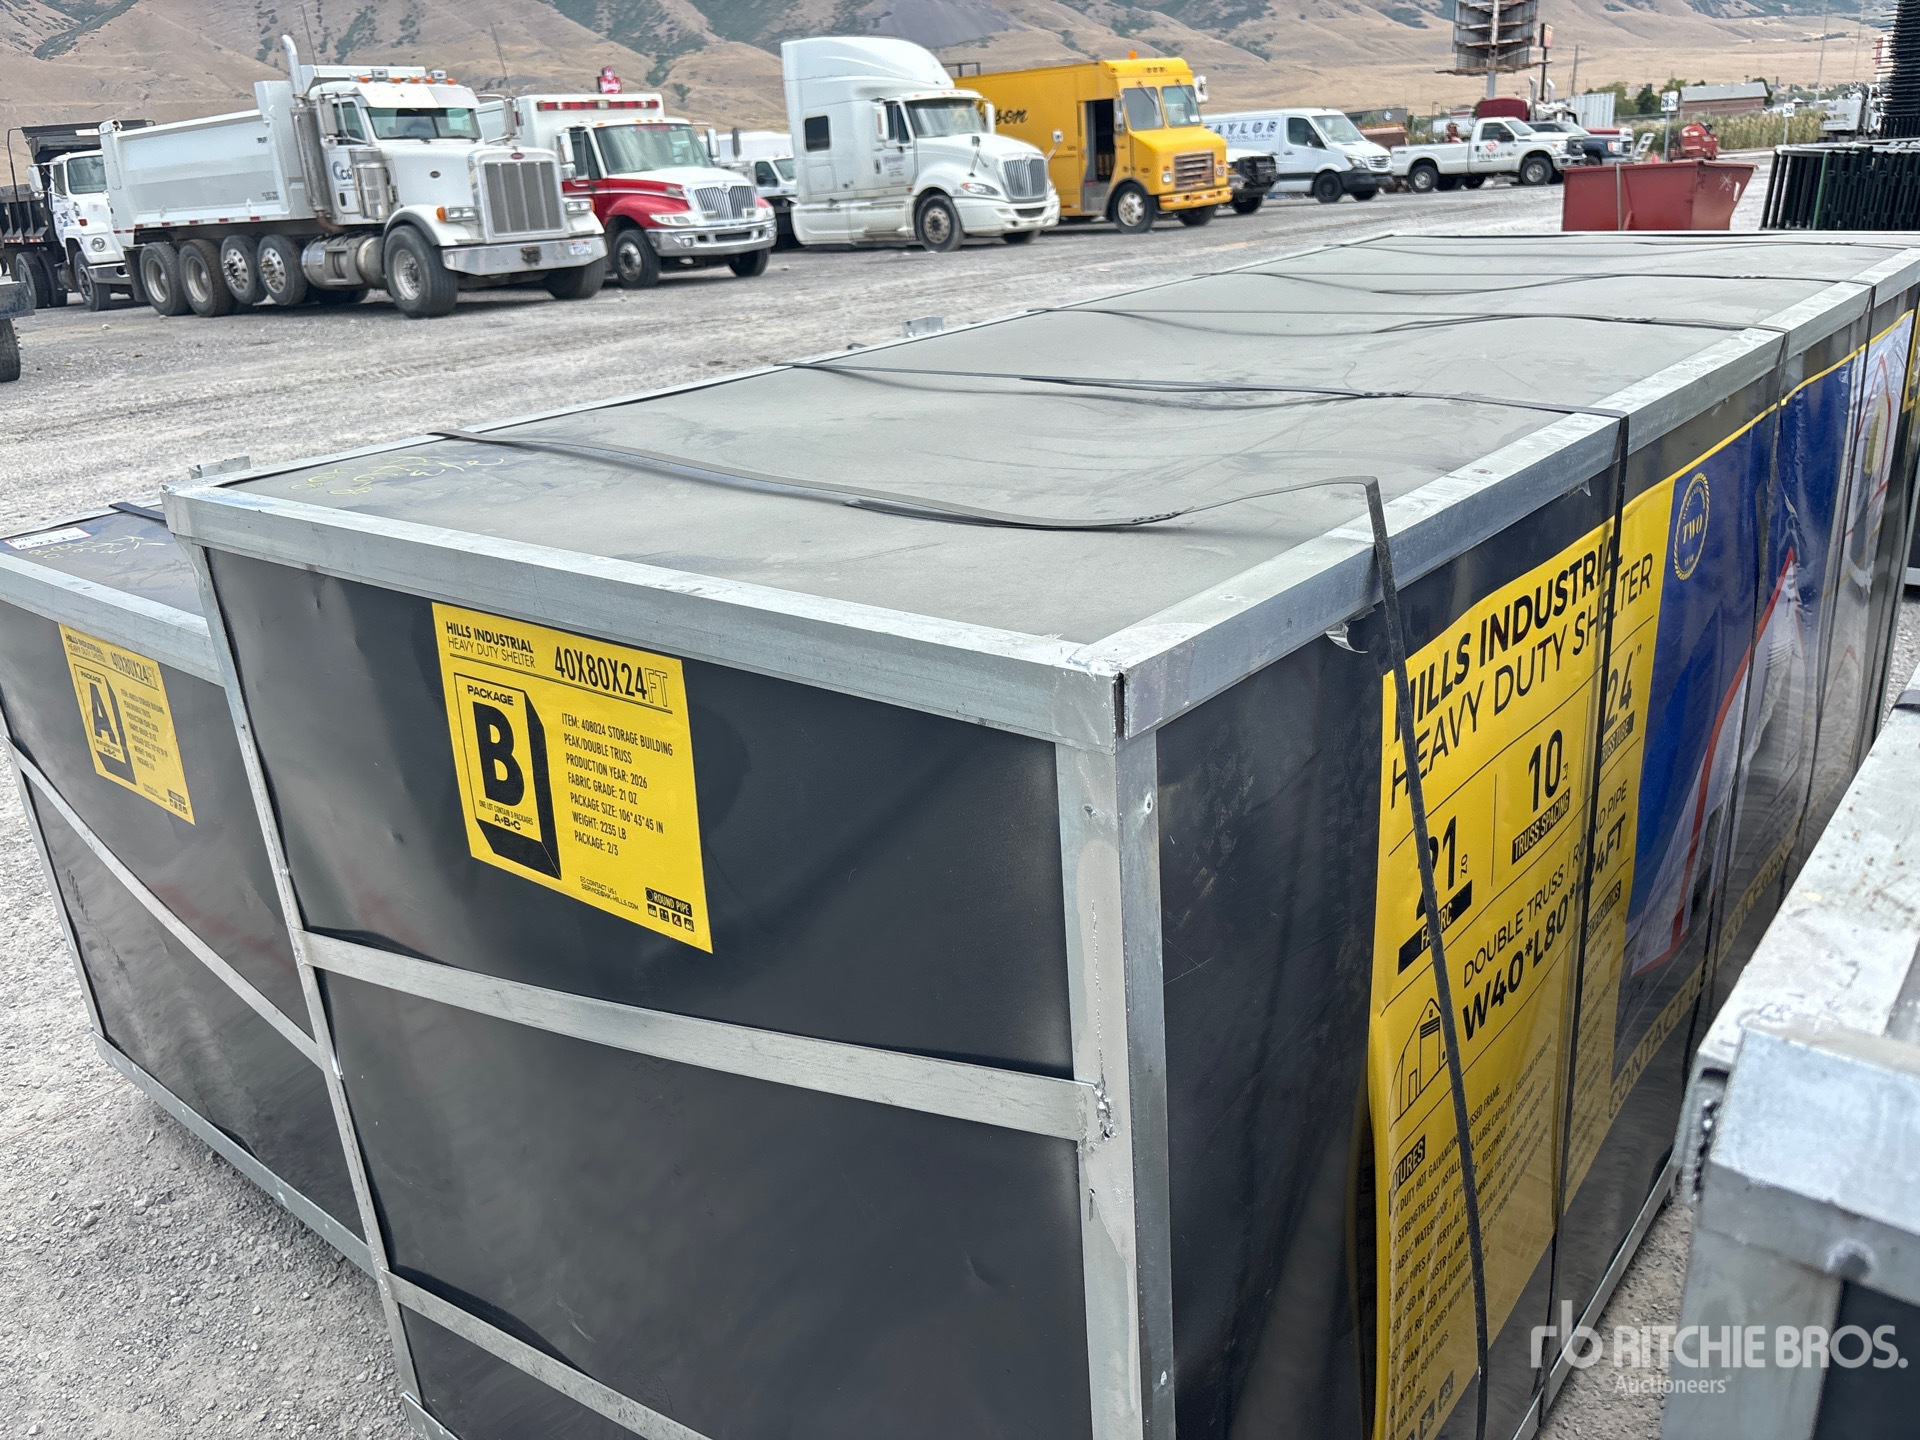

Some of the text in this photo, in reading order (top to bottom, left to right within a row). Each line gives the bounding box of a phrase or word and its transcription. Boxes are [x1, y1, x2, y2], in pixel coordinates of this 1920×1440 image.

[1204, 121, 1278, 135] AYLOR
[1683, 513, 1703, 545] TWO
[1479, 534, 1622, 668] INDUSTRIA
[446, 621, 534, 653] HILLS INDUSTRIAL
[448, 636, 535, 668] HEAVY DUTY SHELTER
[554, 646, 668, 707] 40X80X24FT
[1391, 553, 1653, 809] HEAVY DUTY SHETER
[89, 682, 118, 746] A
[467, 685, 514, 706] PACKAGE
[561, 712, 673, 756] ITEM: 408024 STORAGE BUILDING
[563, 733, 632, 764] PEAK/DOUBLE TRUSS
[472, 701, 524, 806] B
[566, 752, 648, 789] PRODUCTION YEAR: 2026
[1528, 729, 1562, 813] 10
[568, 772, 638, 805] FABRIC GRADE: 21 OZ
[570, 792, 600, 812] PACKAGE
[601, 802, 617, 818] SIZE:
[656, 820, 664, 834] IN
[572, 811, 627, 840] WEIGHT: 2235 LB
[1514, 790, 1570, 862] TRUSS SPACING
[574, 830, 619, 856] PACKAGE: 2/3
[586, 878, 607, 892] CONTACT
[1464, 909, 1524, 989] DOUBLE
[1527, 863, 1564, 922] TRUSS
[1607, 778, 1628, 819] PIPE
[653, 891, 690, 915] ROUND PIPE
[1400, 1185, 1415, 1211] DUTY
[1428, 1134, 1458, 1177] GALVANIZIN
